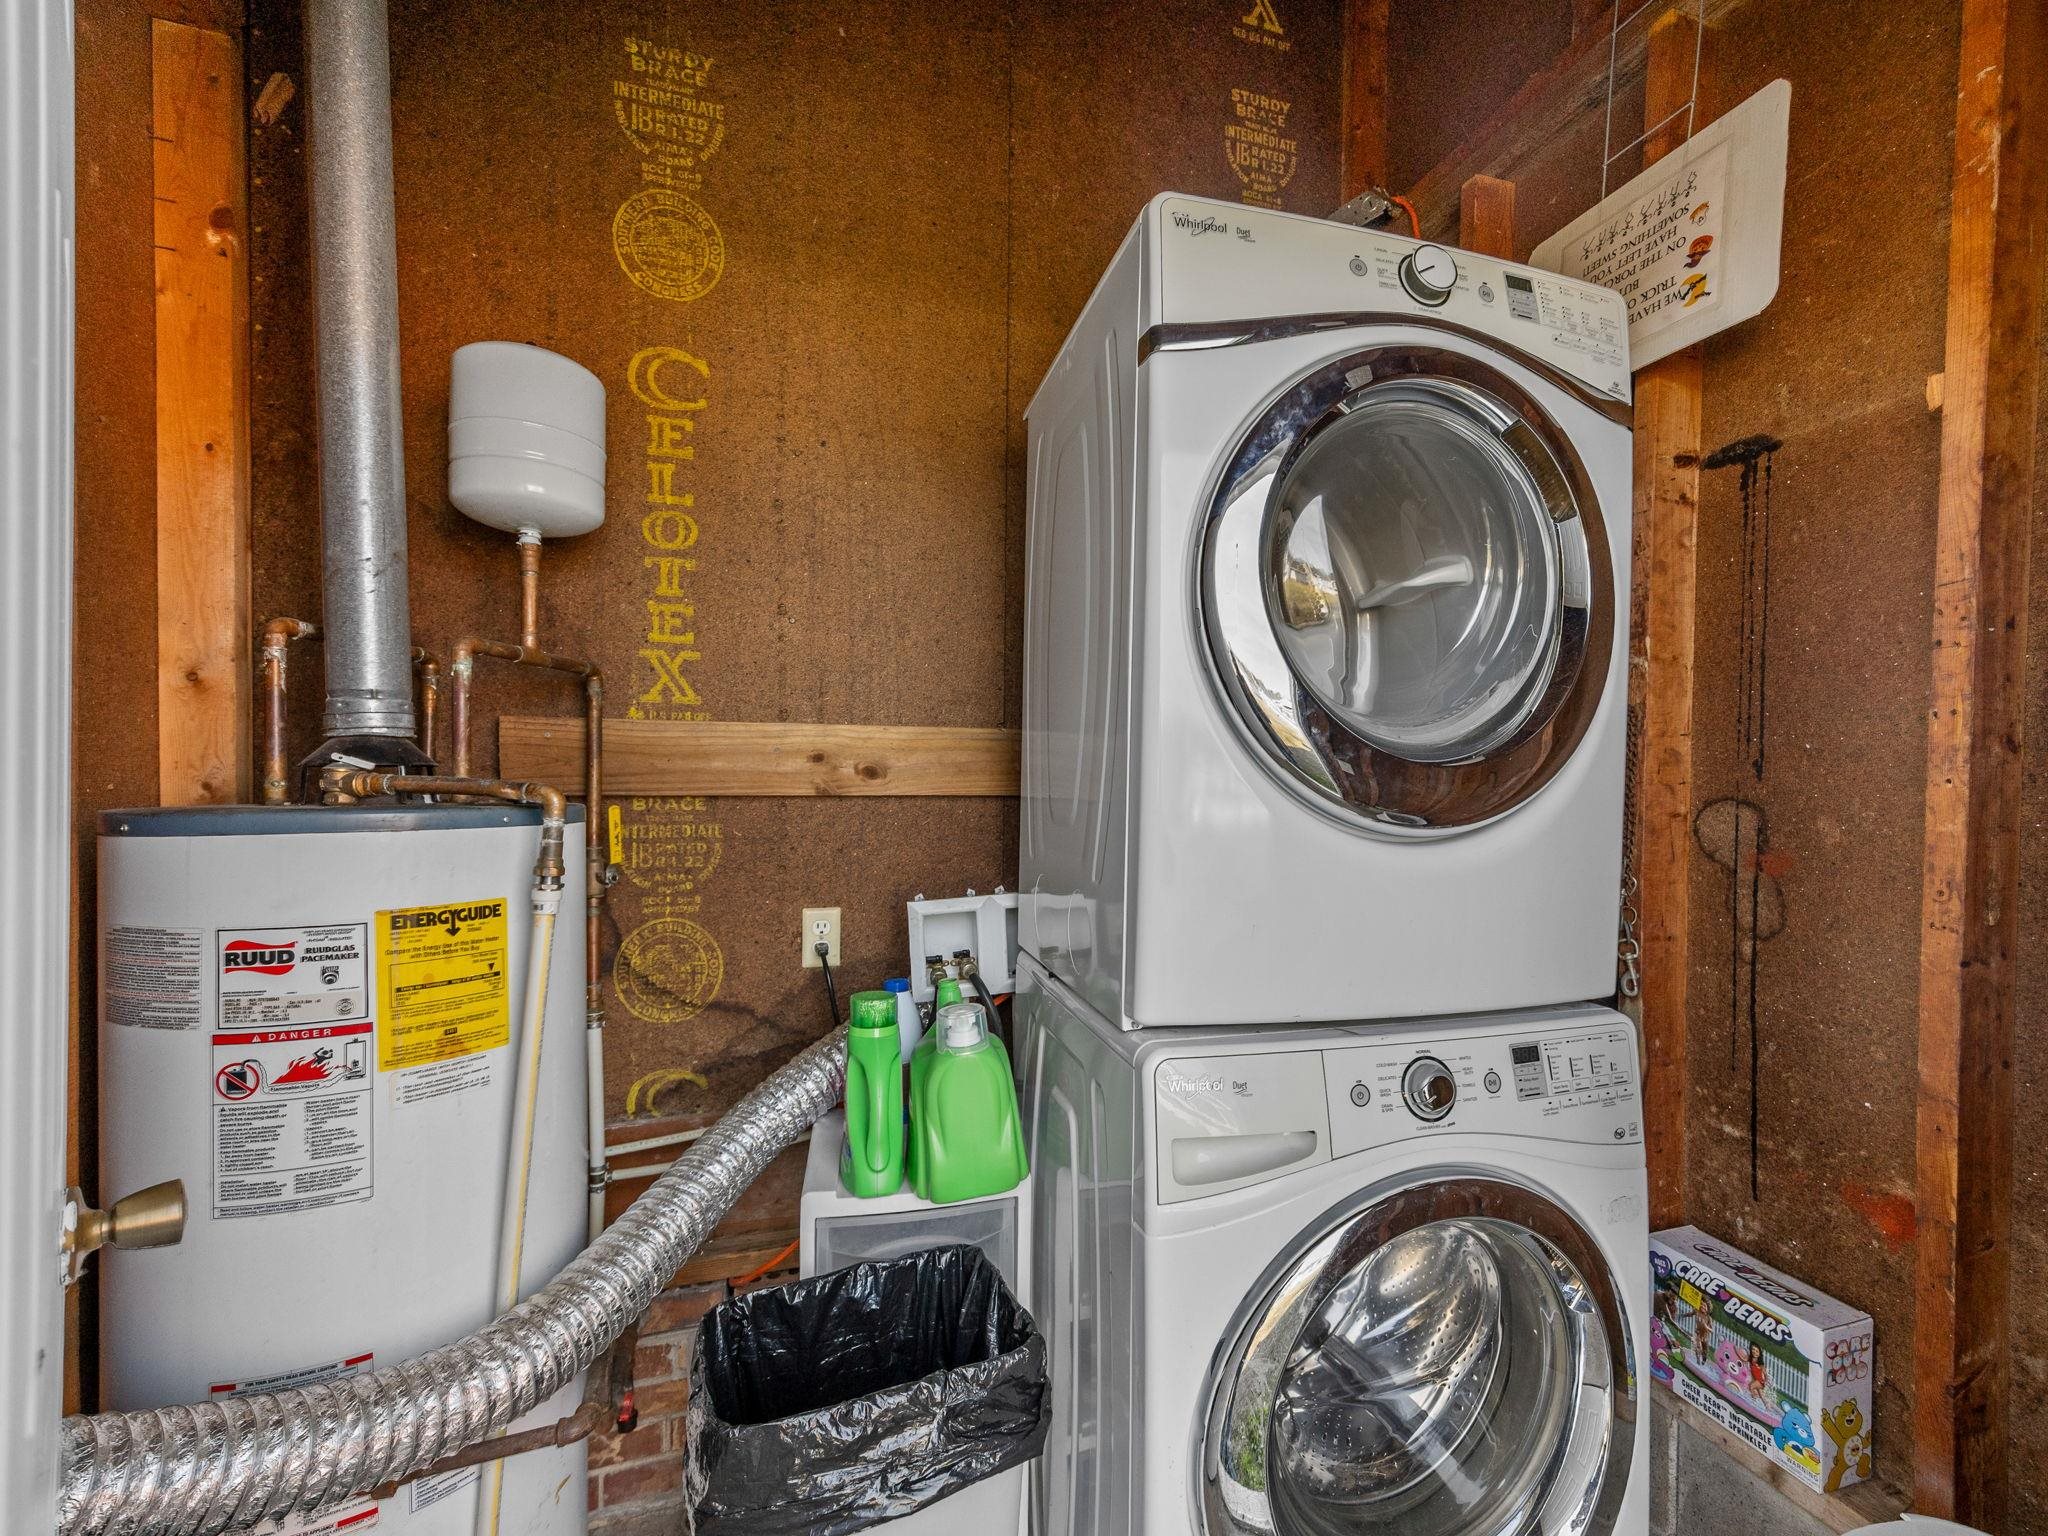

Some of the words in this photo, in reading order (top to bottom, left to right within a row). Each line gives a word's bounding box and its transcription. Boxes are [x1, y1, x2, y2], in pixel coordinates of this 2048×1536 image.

[624, 36, 714, 71] STURDY
[631, 53, 708, 86] BRACE
[613, 80, 724, 121] INTERMEDIATE
[1231, 88, 1291, 113] STURDY
[655, 109, 709, 132] RATED
[1225, 124, 1297, 152] INTERMEDIATE
[1251, 146, 1286, 163] RATED
[1172, 216, 1228, 235] Whirlpool
[1620, 203, 1690, 254] SOMETHING
[1645, 226, 1677, 253] HAVE
[1665, 236, 1687, 255] ON
[1616, 248, 1642, 270] LEFT
[1640, 251, 1662, 270] THE
[1589, 266, 1612, 284] YOU
[1641, 276, 1677, 303] TRICK
[1664, 288, 1683, 304] WE
[1628, 299, 1661, 325] HAVE
[627, 345, 711, 704] CELOTEX
[225, 949, 295, 967] RUUD
[301, 952, 360, 963] PACEMAKER
[305, 944, 356, 954] RUUDGLAS
[268, 1028, 332, 1041] DANGER
[1167, 1077, 1224, 1095] Whirlpool
[1232, 1080, 1248, 1090] Duet
[1675, 1260, 1725, 1296] CARE
[1723, 1297, 1792, 1342] BEARS
[1826, 1333, 1871, 1359] CARE
[268, 1376, 284, 1384] SAFETY
[1682, 1379, 1701, 1397] CHEER
[1729, 1411, 1772, 1447] INFLATABLE
[1728, 1420, 1768, 1454] SPRINKLER
